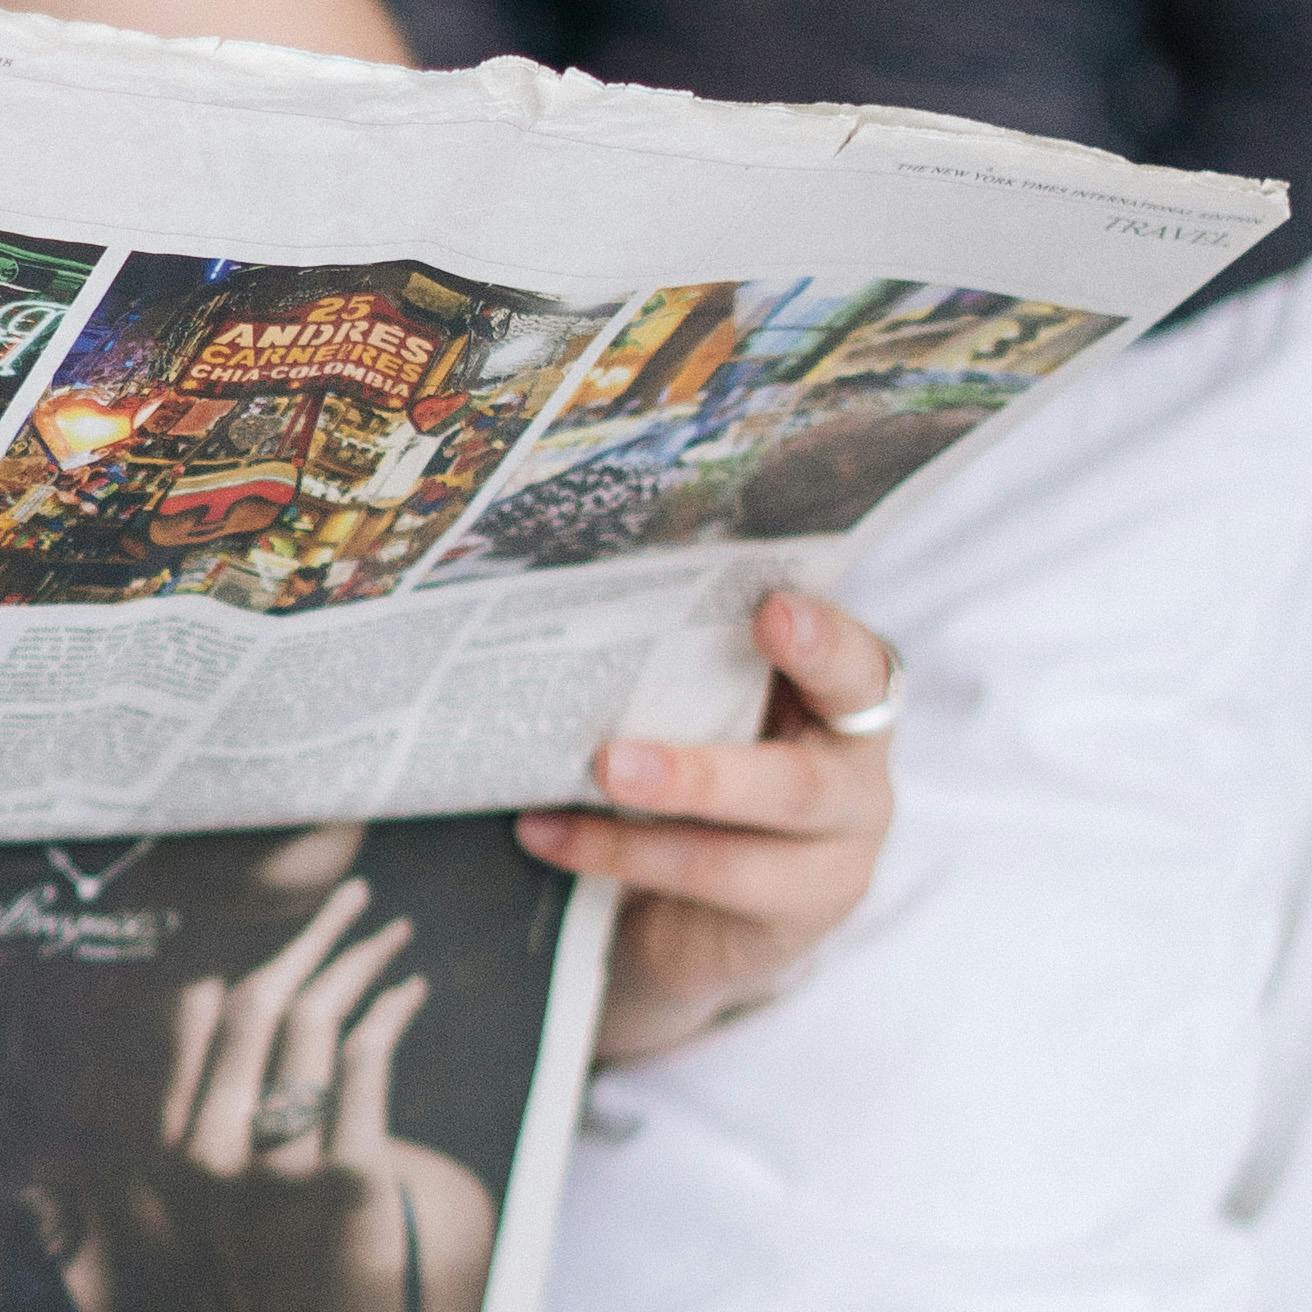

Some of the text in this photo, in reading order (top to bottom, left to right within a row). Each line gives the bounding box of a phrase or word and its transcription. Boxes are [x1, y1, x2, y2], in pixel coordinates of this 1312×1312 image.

[898, 163, 1263, 225] THE NEW YORK TIMES INTERNATIONAL EDITION
[1105, 215, 1230, 248] TRAVEL
[307, 295, 376, 323] 25
[201, 344, 336, 367] CARNE
